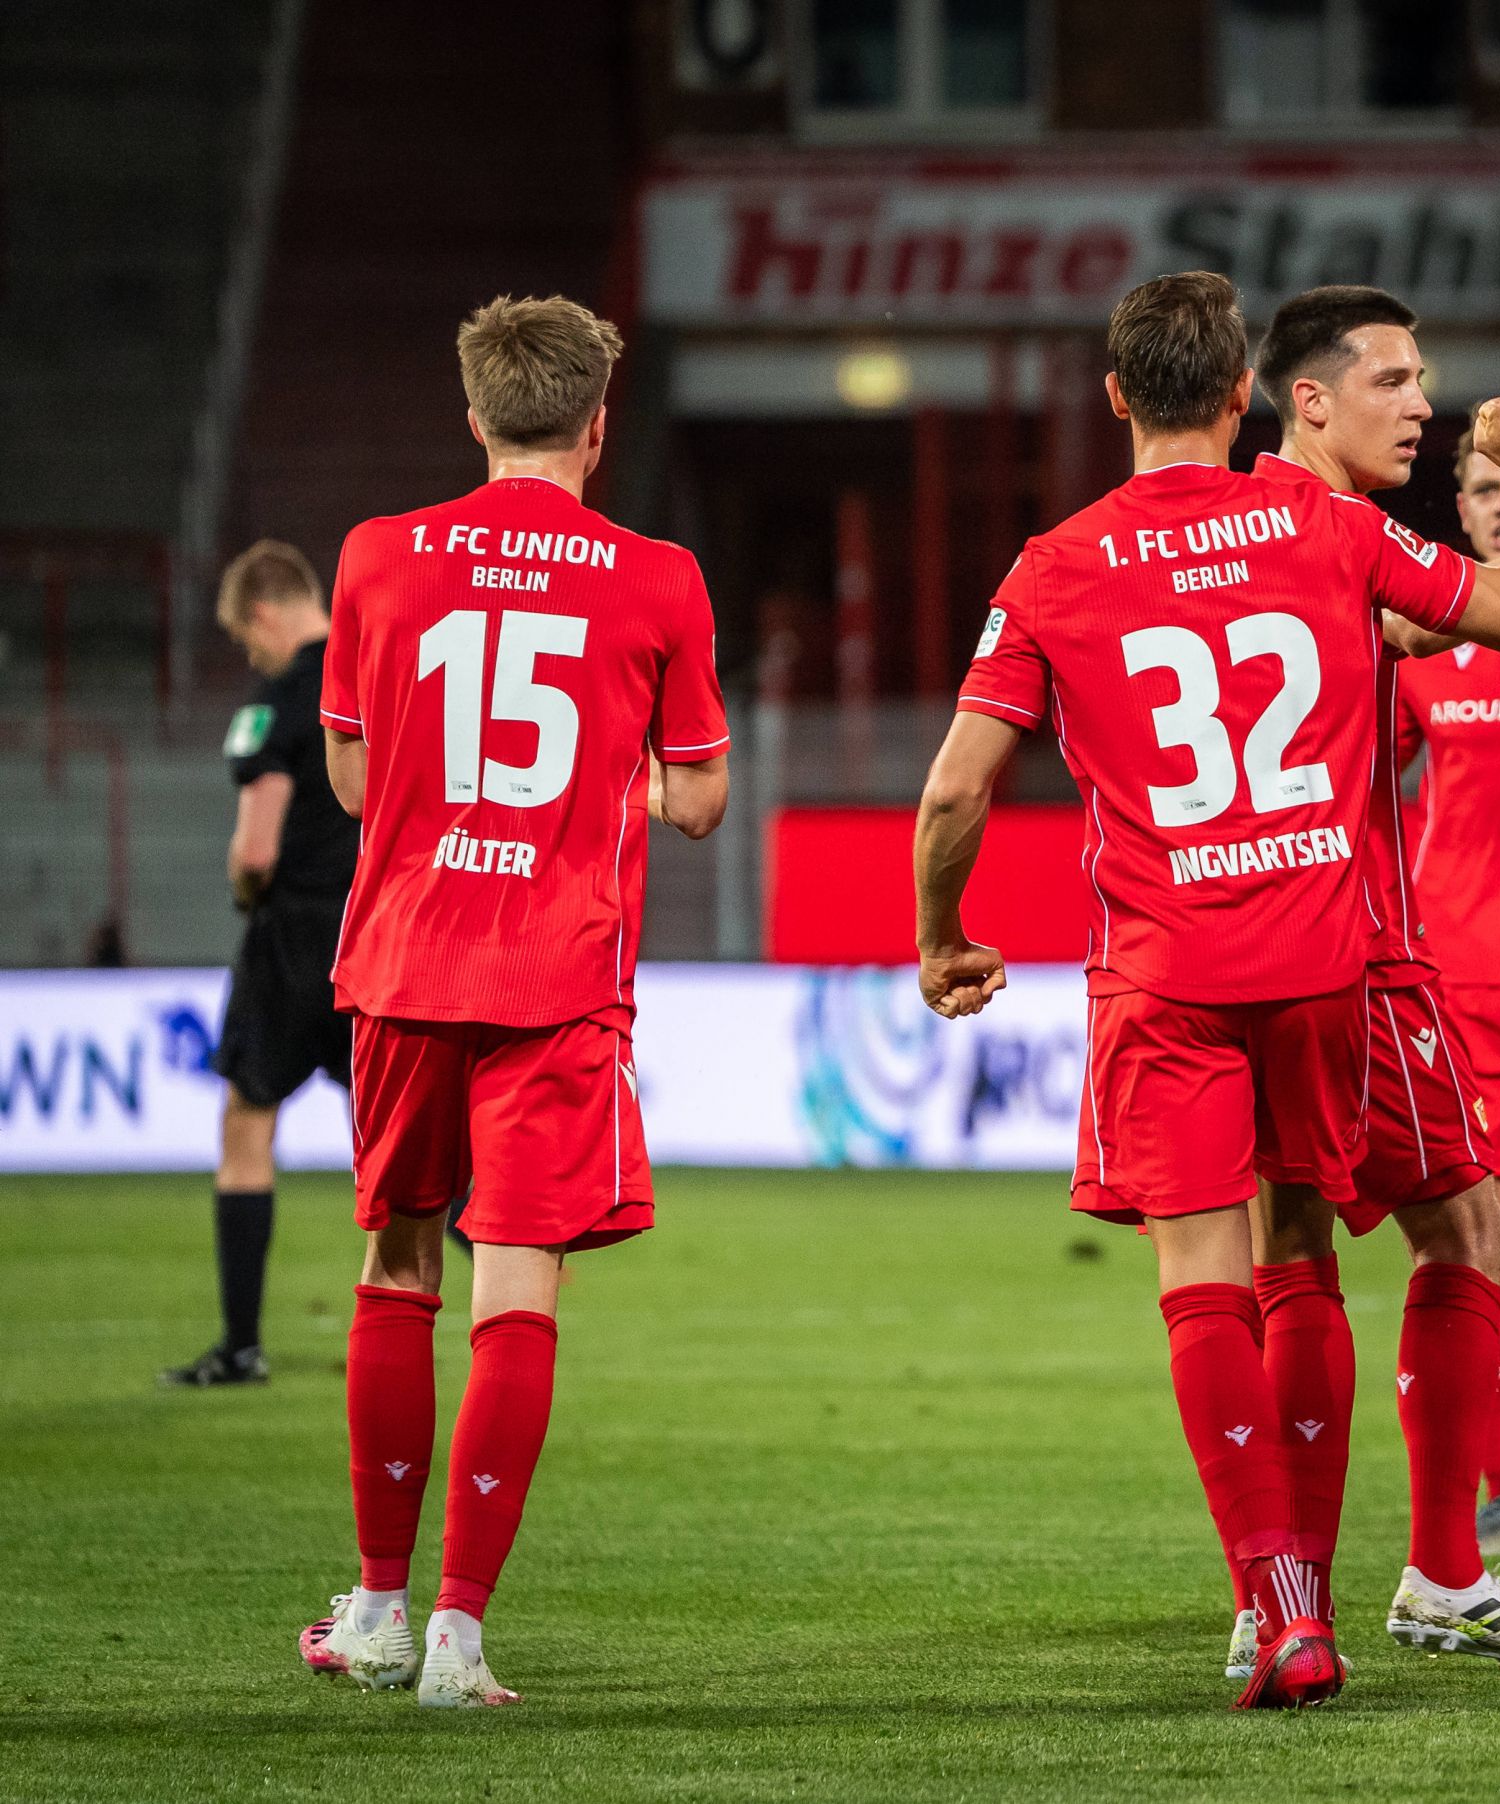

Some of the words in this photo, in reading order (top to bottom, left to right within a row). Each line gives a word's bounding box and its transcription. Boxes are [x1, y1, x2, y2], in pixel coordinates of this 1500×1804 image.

[411, 524, 434, 553] 1.
[446, 524, 490, 555] FC
[499, 530, 617, 570] UNION
[1099, 534, 1129, 568] 1.
[1135, 529, 1179, 563] FC
[1184, 506, 1297, 554] UNION
[471, 566, 550, 593] BERLIN
[1171, 559, 1250, 594] BERLIN
[417, 609, 589, 808] 15
[1120, 611, 1334, 828] 32
[432, 826, 537, 879] BÜLTER
[1168, 825, 1353, 885] INGVARTSEN
